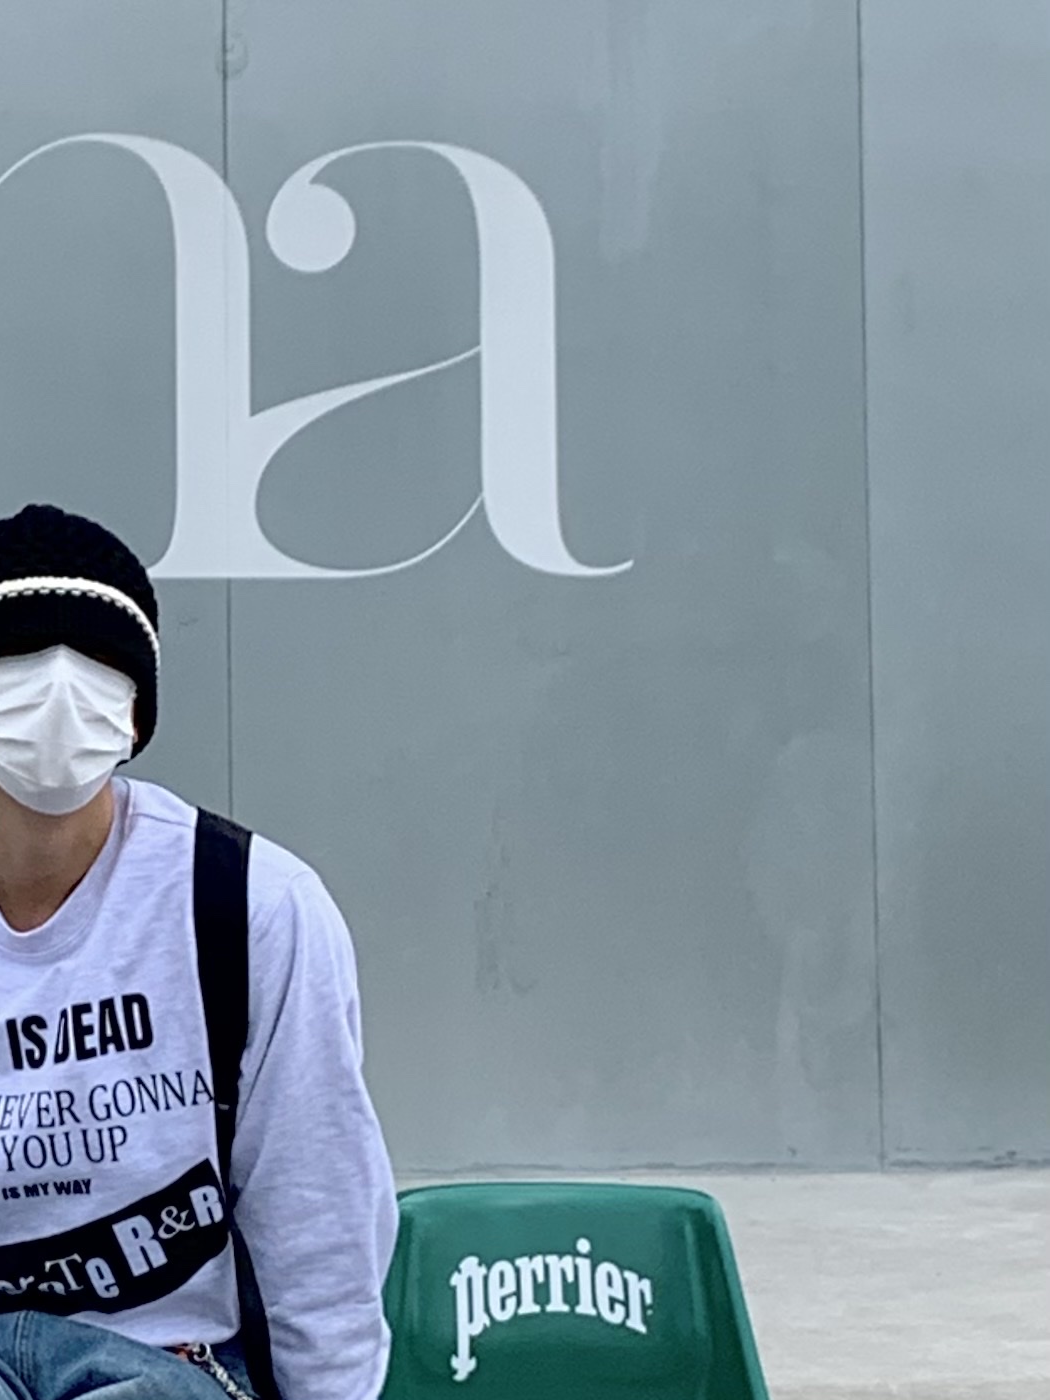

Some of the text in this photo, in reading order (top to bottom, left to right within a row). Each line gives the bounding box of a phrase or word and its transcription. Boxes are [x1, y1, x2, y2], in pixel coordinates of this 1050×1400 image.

[5, 1015, 48, 1070] IS
[54, 993, 153, 1064] DEAD
[88, 1069, 214, 1121] GONNA
[0, 1131, 72, 1171] YOU
[81, 1125, 127, 1163] UP
[2, 1187, 20, 1200] IS
[23, 1182, 49, 1197] MY
[53, 1178, 91, 1195] WAY
